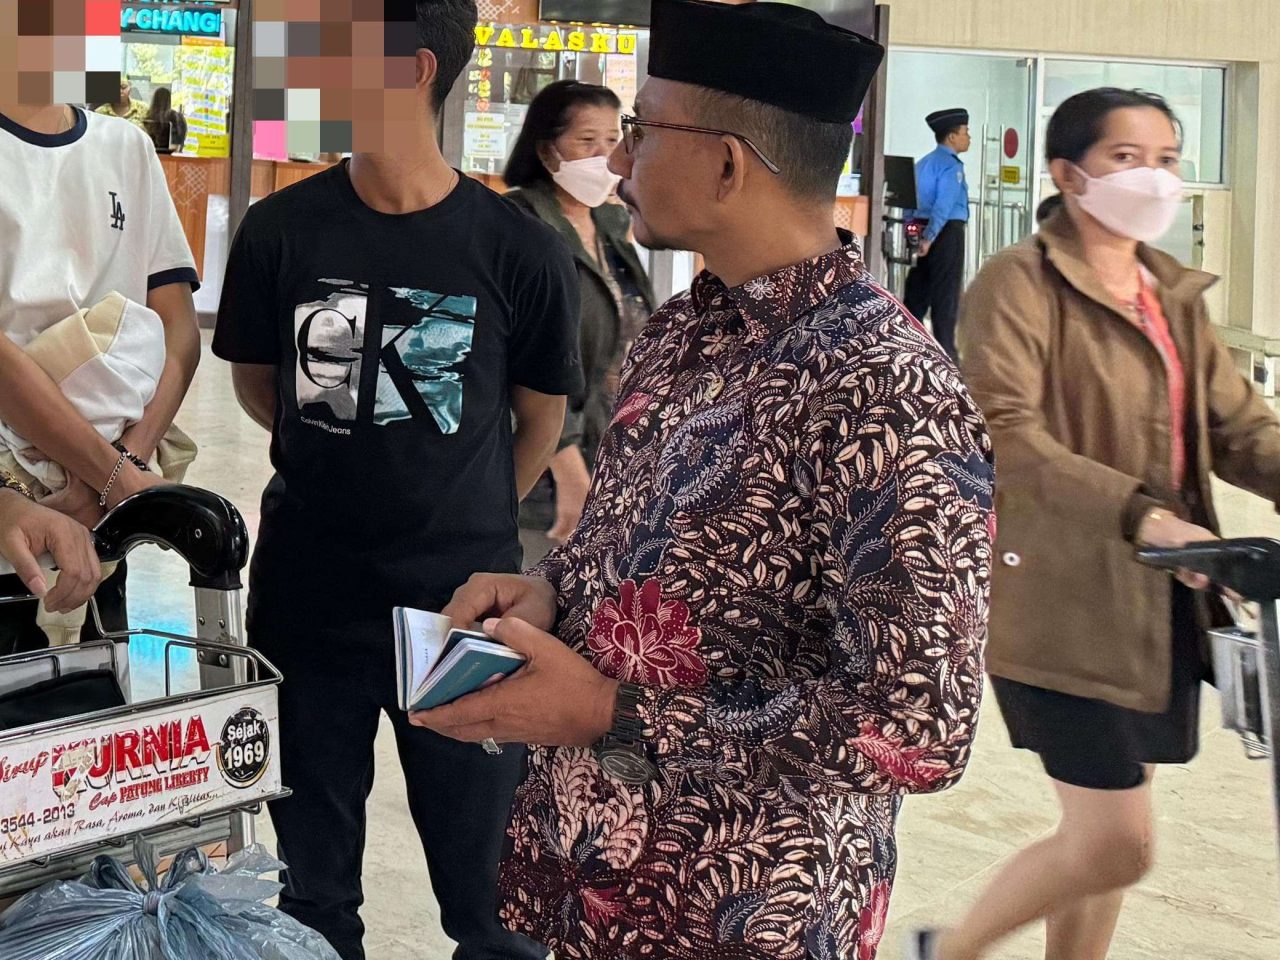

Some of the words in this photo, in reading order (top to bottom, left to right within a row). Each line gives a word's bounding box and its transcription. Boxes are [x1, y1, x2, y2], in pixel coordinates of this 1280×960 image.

[224, 742, 266, 770] 1969
[88, 791, 118, 811] Cap
[164, 766, 211, 791] LIBERTY
